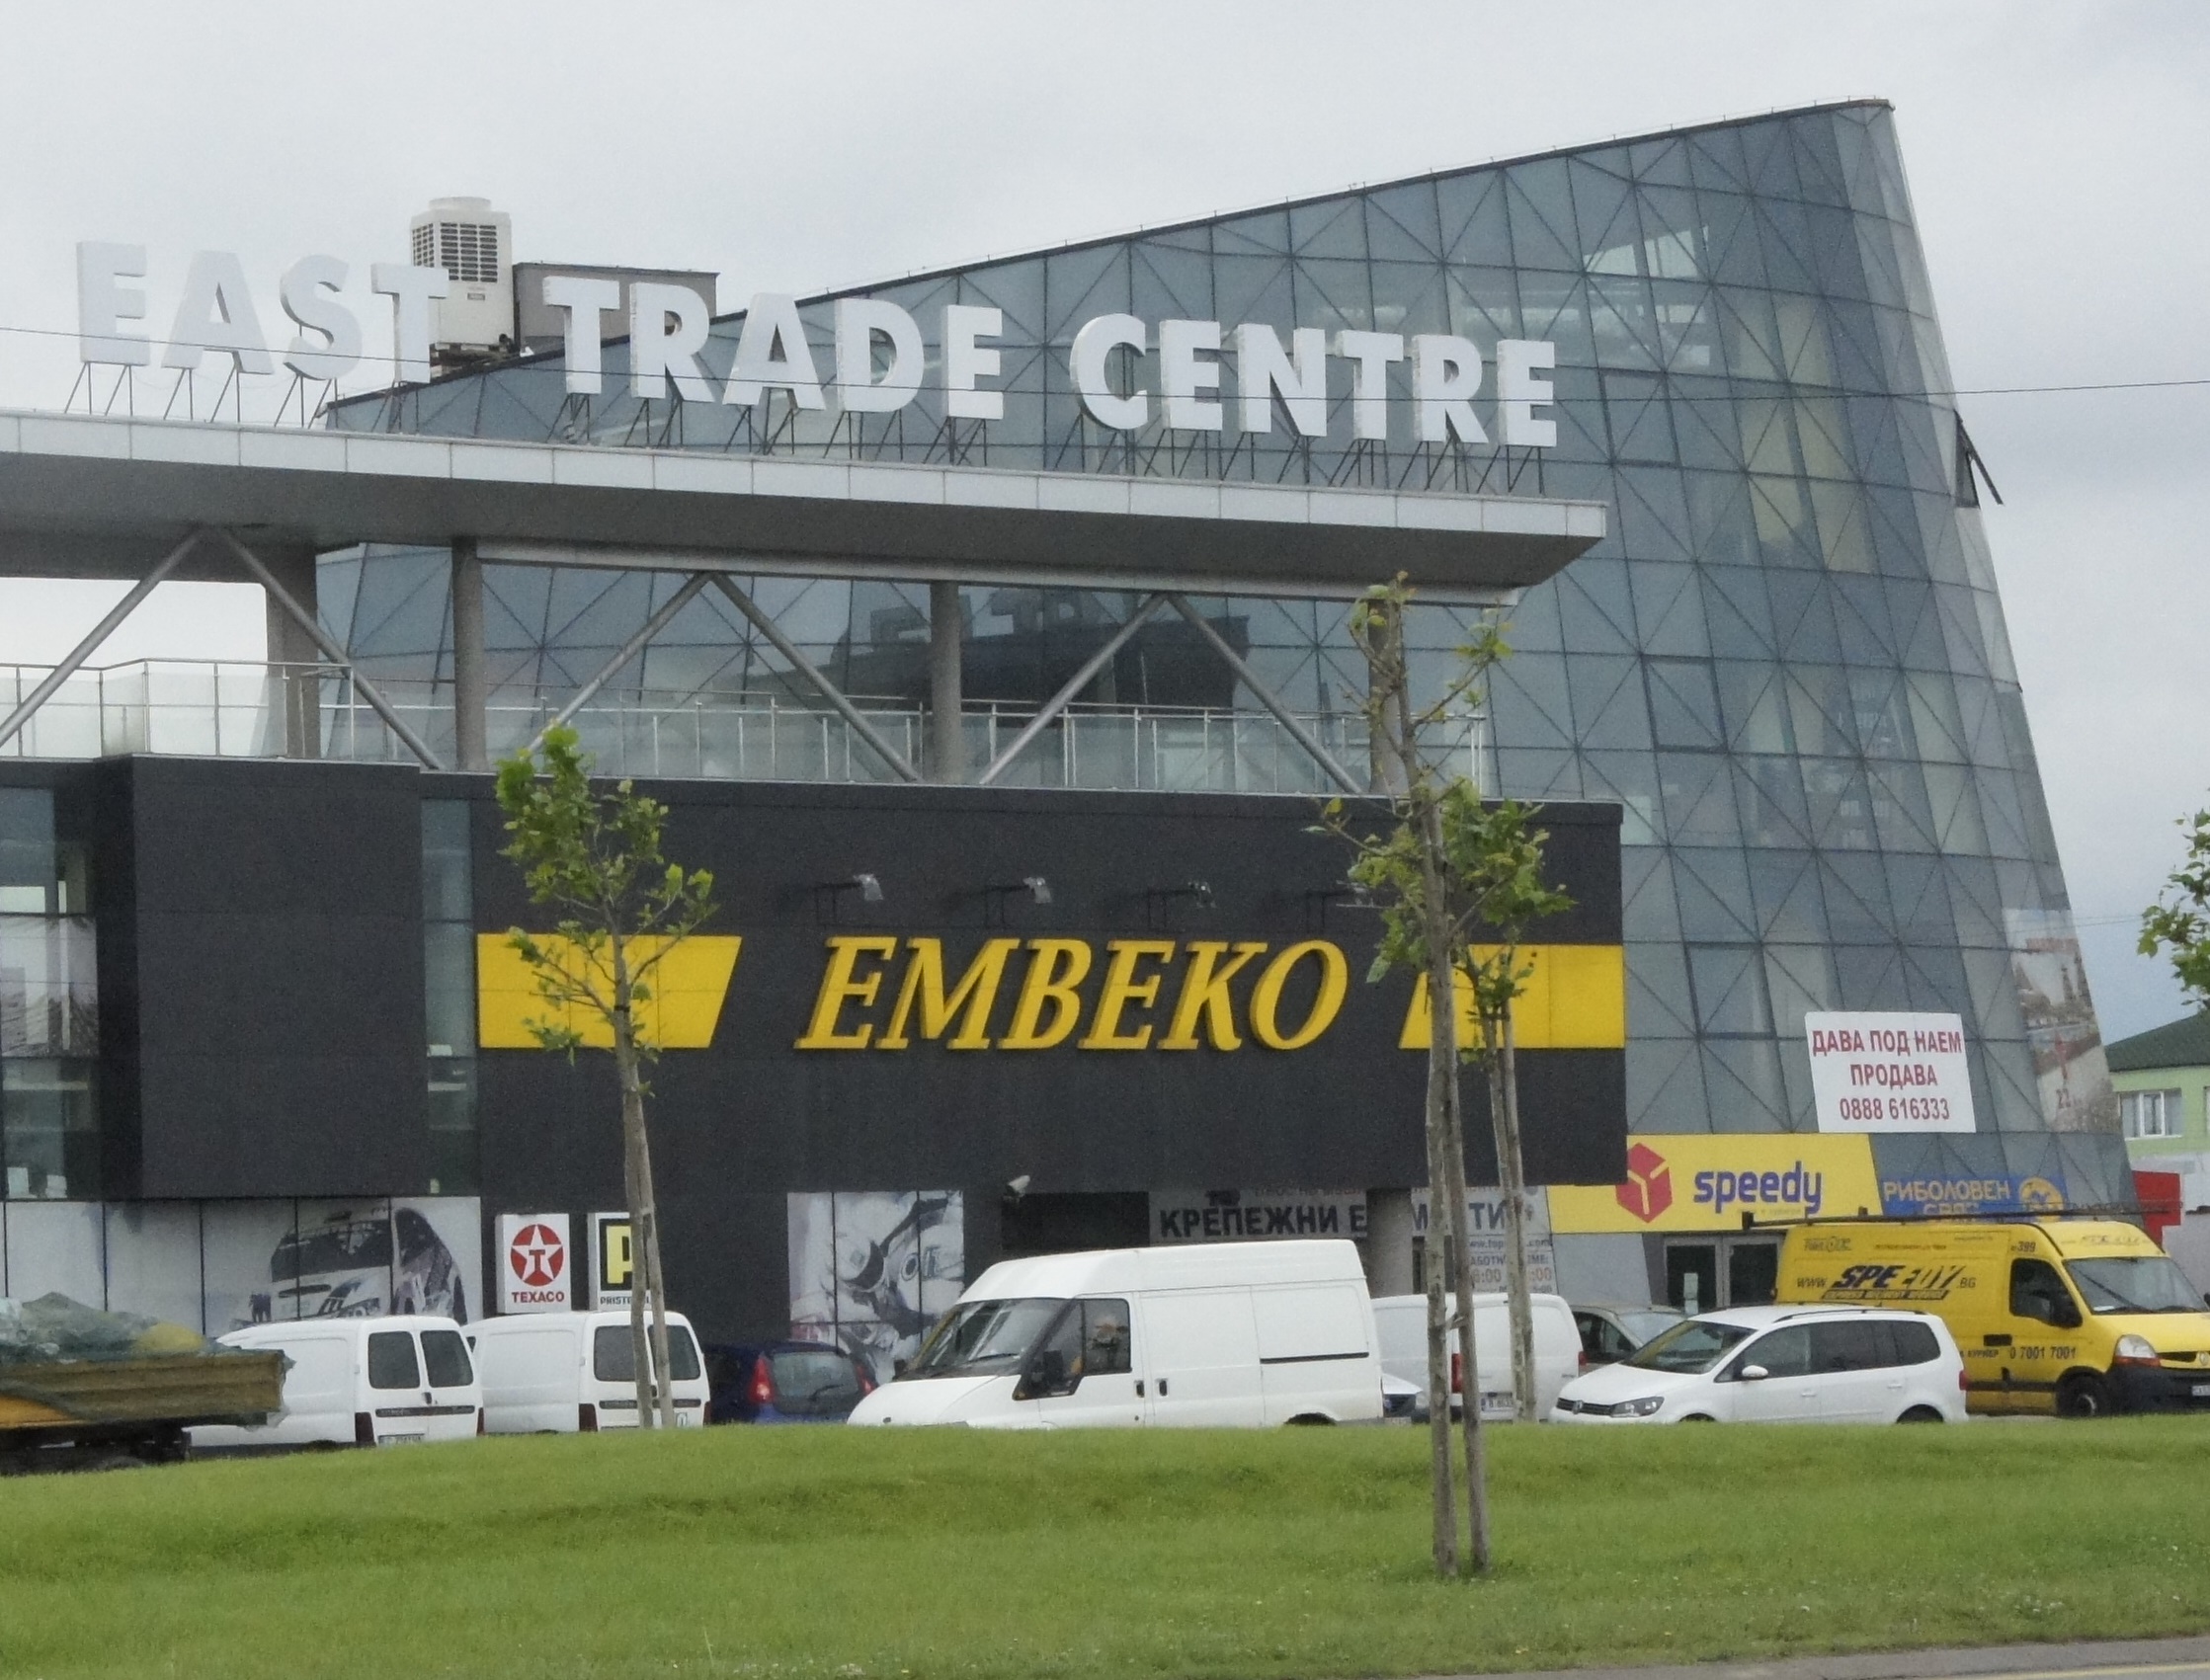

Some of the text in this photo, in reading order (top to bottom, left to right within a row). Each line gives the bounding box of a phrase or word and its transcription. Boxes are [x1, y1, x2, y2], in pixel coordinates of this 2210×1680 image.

[76, 241, 1558, 448] EAST TRADE CENTRE
[1812, 1030, 1962, 1057] ДАВА ПОД НАЕМ
[1850, 1064, 1938, 1090] ПРОДАВА
[1840, 1098, 1950, 1121] 0888 616333
[1693, 1160, 1822, 1214] speedy
[1883, 1180, 2009, 1202] РИБОЛОВЕН
[1160, 1205, 1338, 1238] КРЕПЕЖНИ
[511, 1291, 565, 1304] TEXACO
